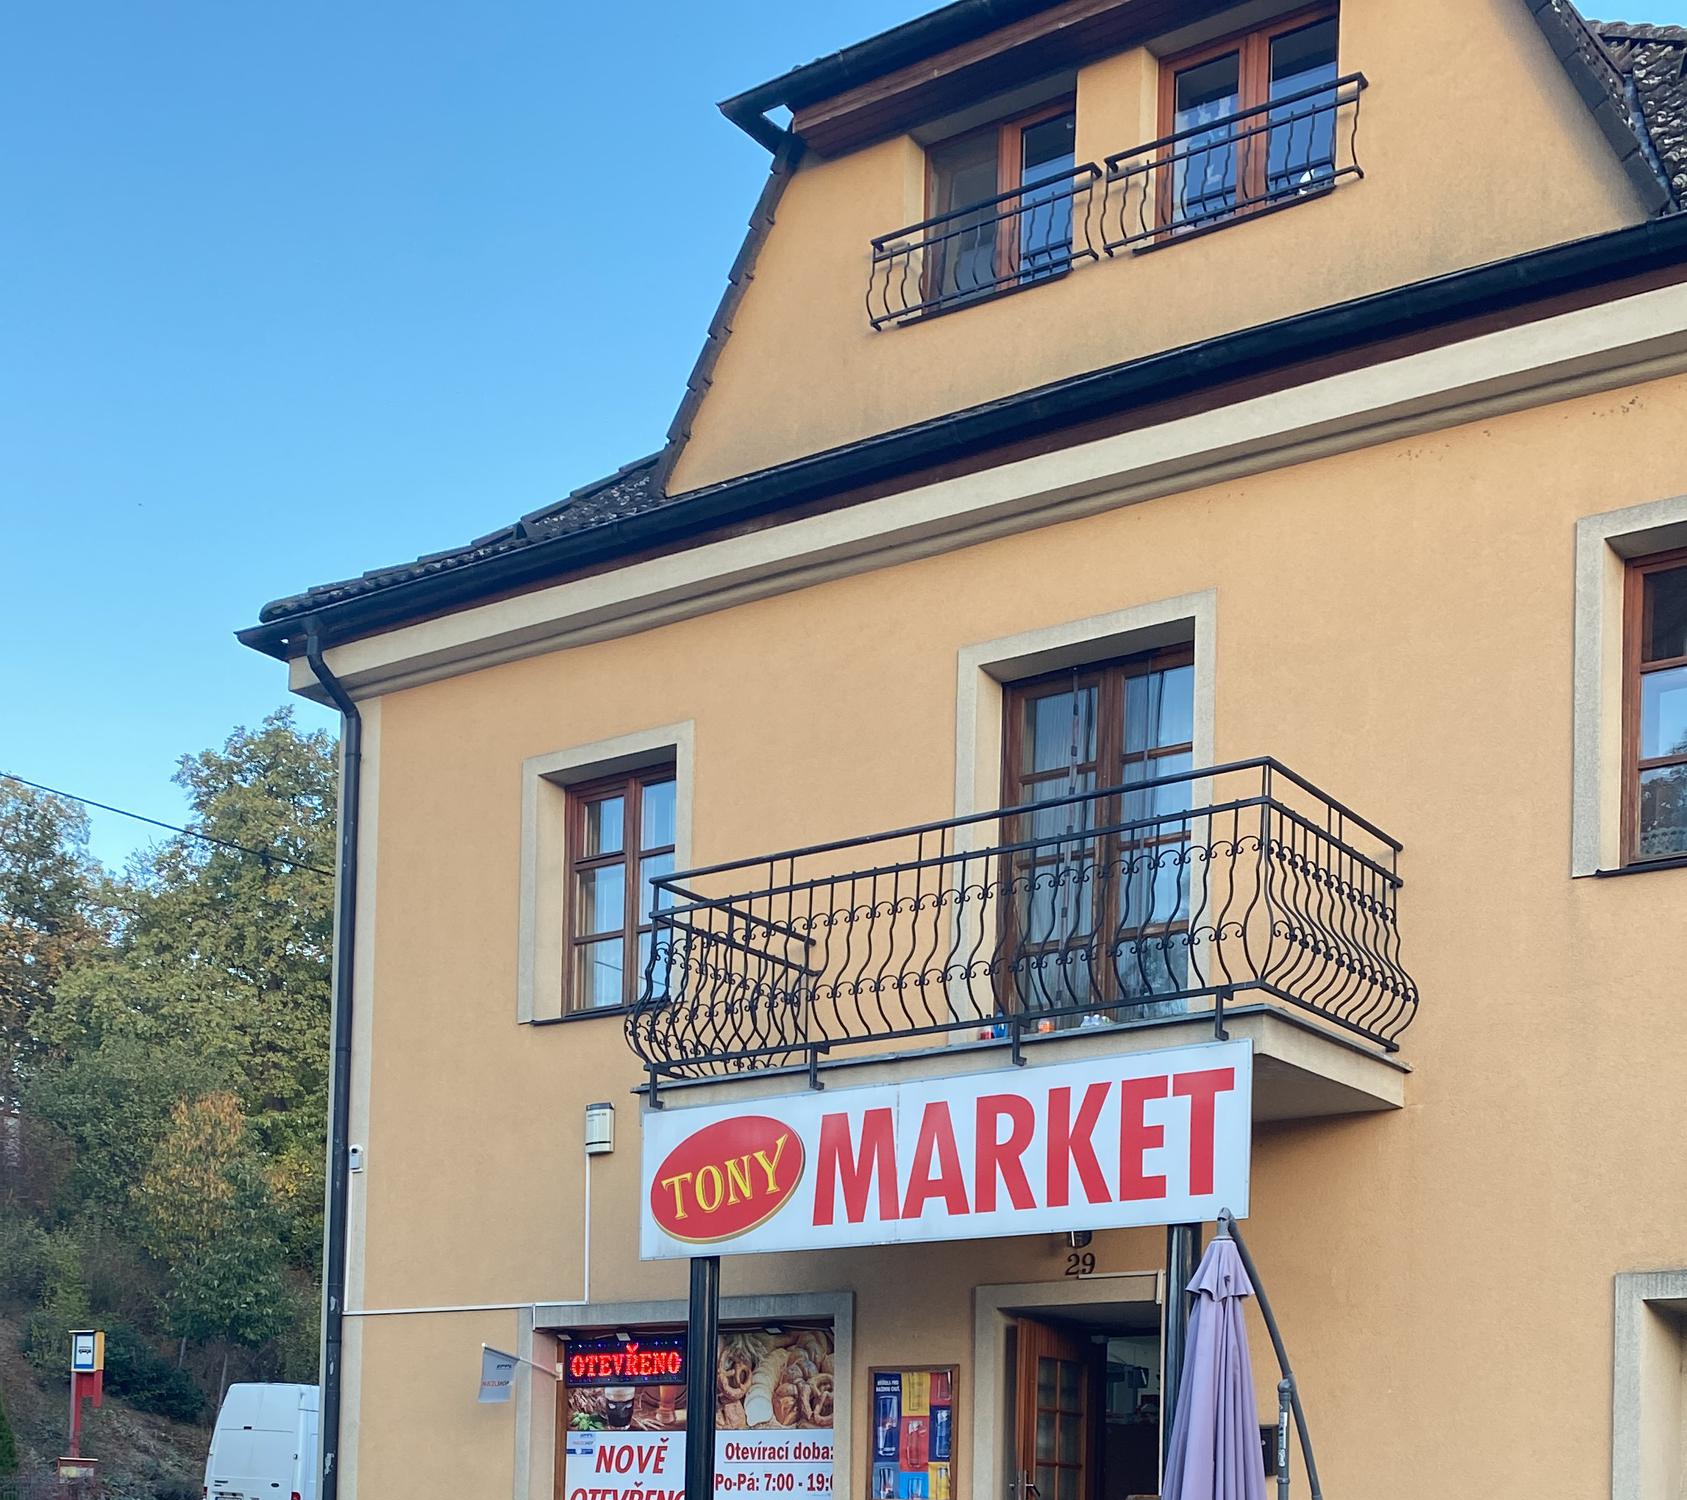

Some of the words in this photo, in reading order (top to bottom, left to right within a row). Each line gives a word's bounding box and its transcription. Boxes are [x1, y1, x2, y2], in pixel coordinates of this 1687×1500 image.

[661, 1133, 789, 1221] TONY
[812, 1067, 1235, 1227] MARKET
[1065, 1252, 1096, 1276] 29
[571, 1343, 682, 1377] OTEVŘENO
[595, 1437, 670, 1474] NOVĚ
[725, 1441, 790, 1460] Otevírací
[715, 1472, 760, 1491] Po-Pá:
[764, 1473, 794, 1491] 7:00
